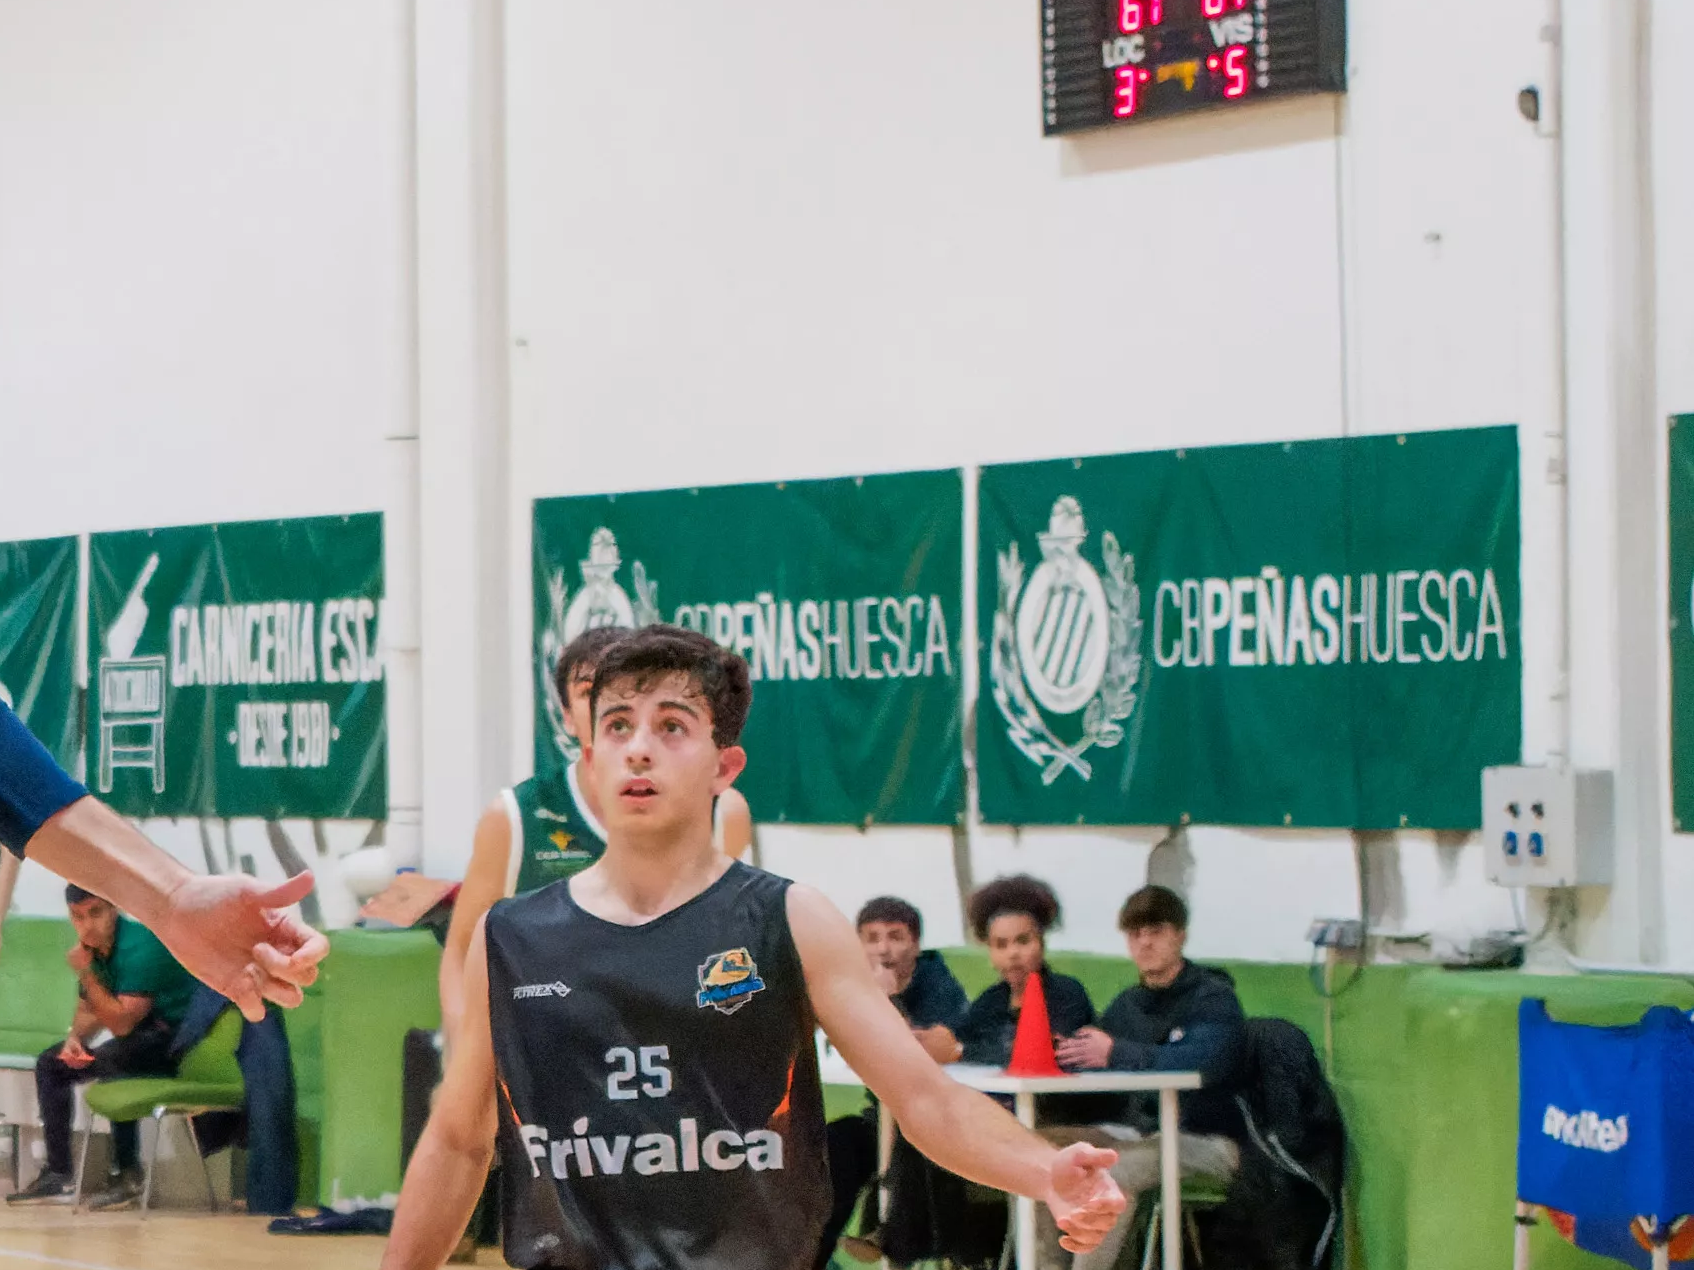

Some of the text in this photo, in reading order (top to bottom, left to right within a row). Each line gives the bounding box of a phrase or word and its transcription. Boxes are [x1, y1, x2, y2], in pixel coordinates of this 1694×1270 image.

[1101, 13, 1255, 68] LOC VIS
[1113, 45, 1249, 117] 3 5
[171, 601, 317, 688] CARNICERIA
[604, 1044, 673, 1100] 25
[518, 1115, 785, 1179] Frivalca
